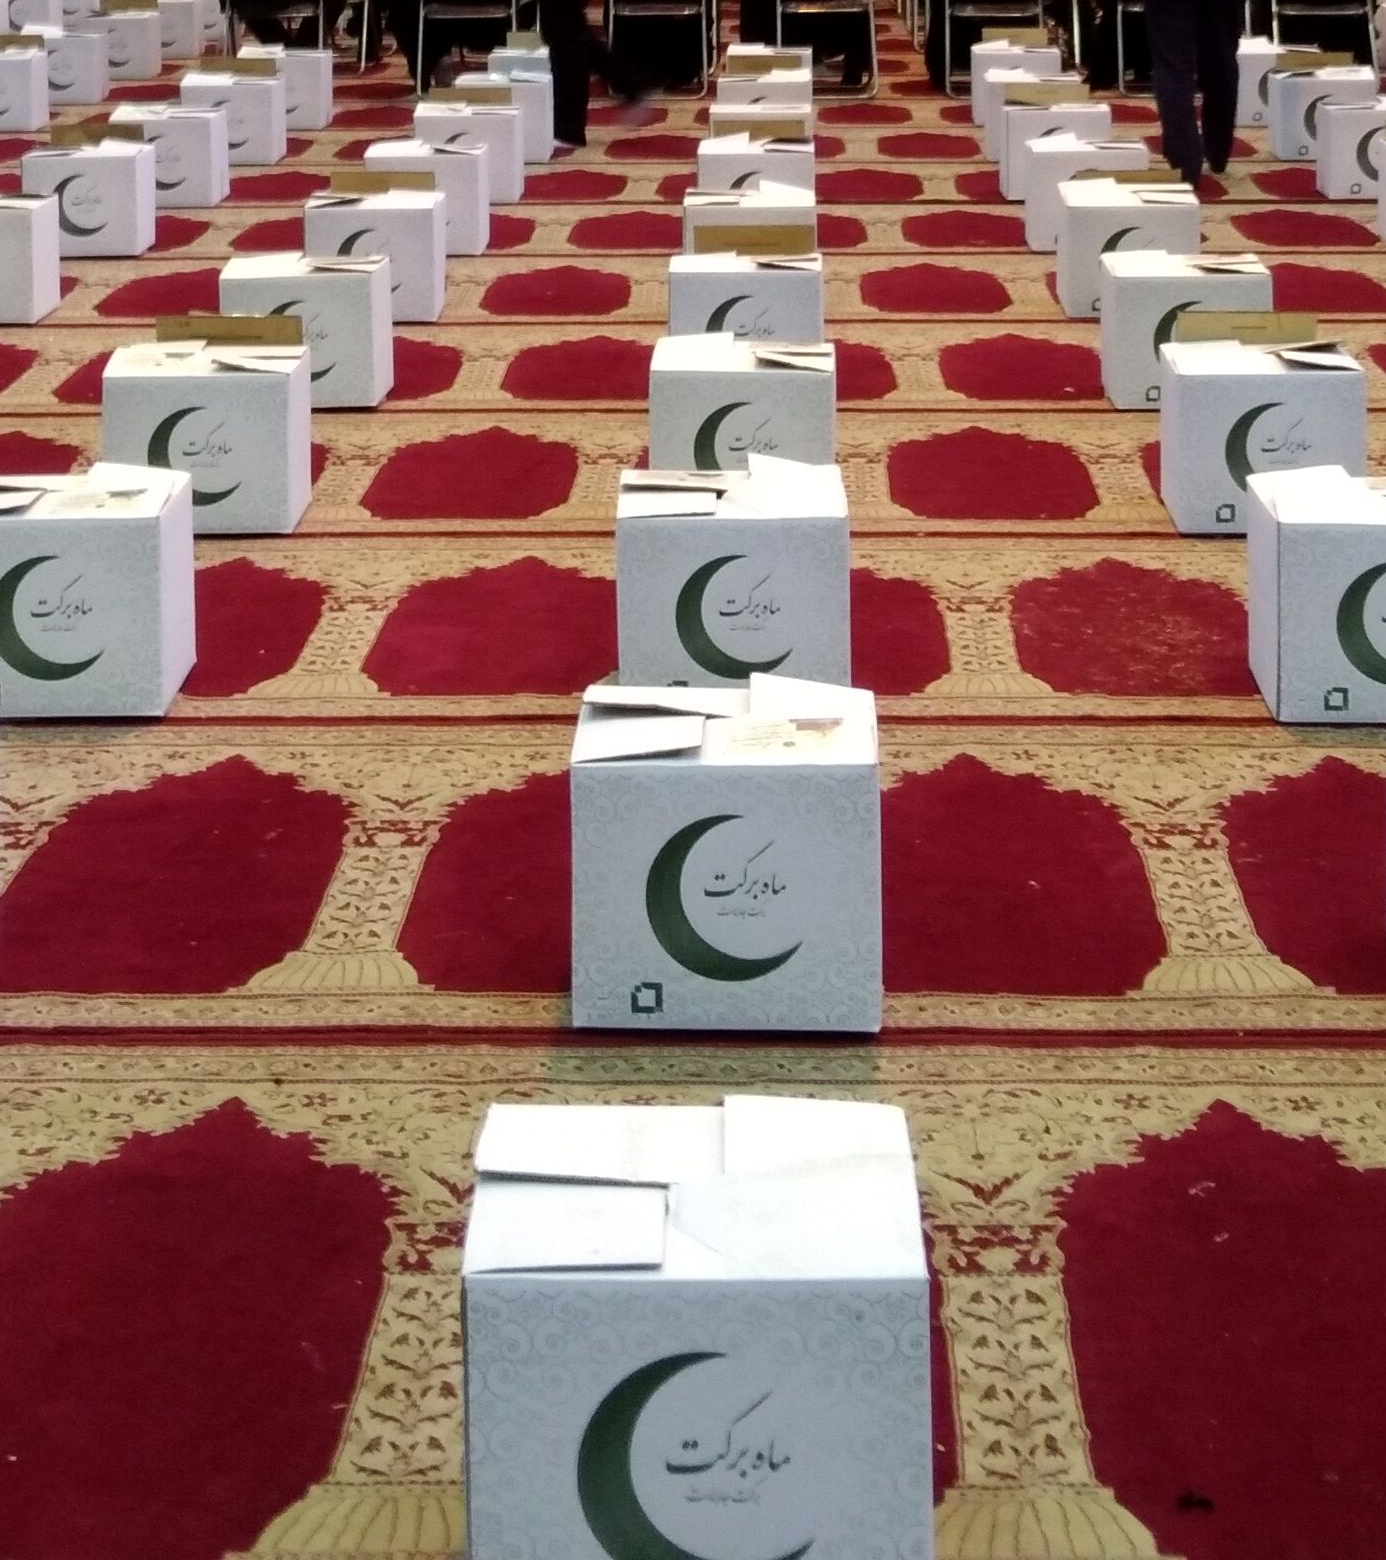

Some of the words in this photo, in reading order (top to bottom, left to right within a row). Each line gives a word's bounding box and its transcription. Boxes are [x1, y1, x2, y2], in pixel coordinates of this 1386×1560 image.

[719, 574, 771, 618] برکت
[703, 839, 775, 900] برکت
[761, 872, 786, 896] ماه
[665, 1390, 773, 1479] برکت
[751, 1438, 791, 1472] ماه
